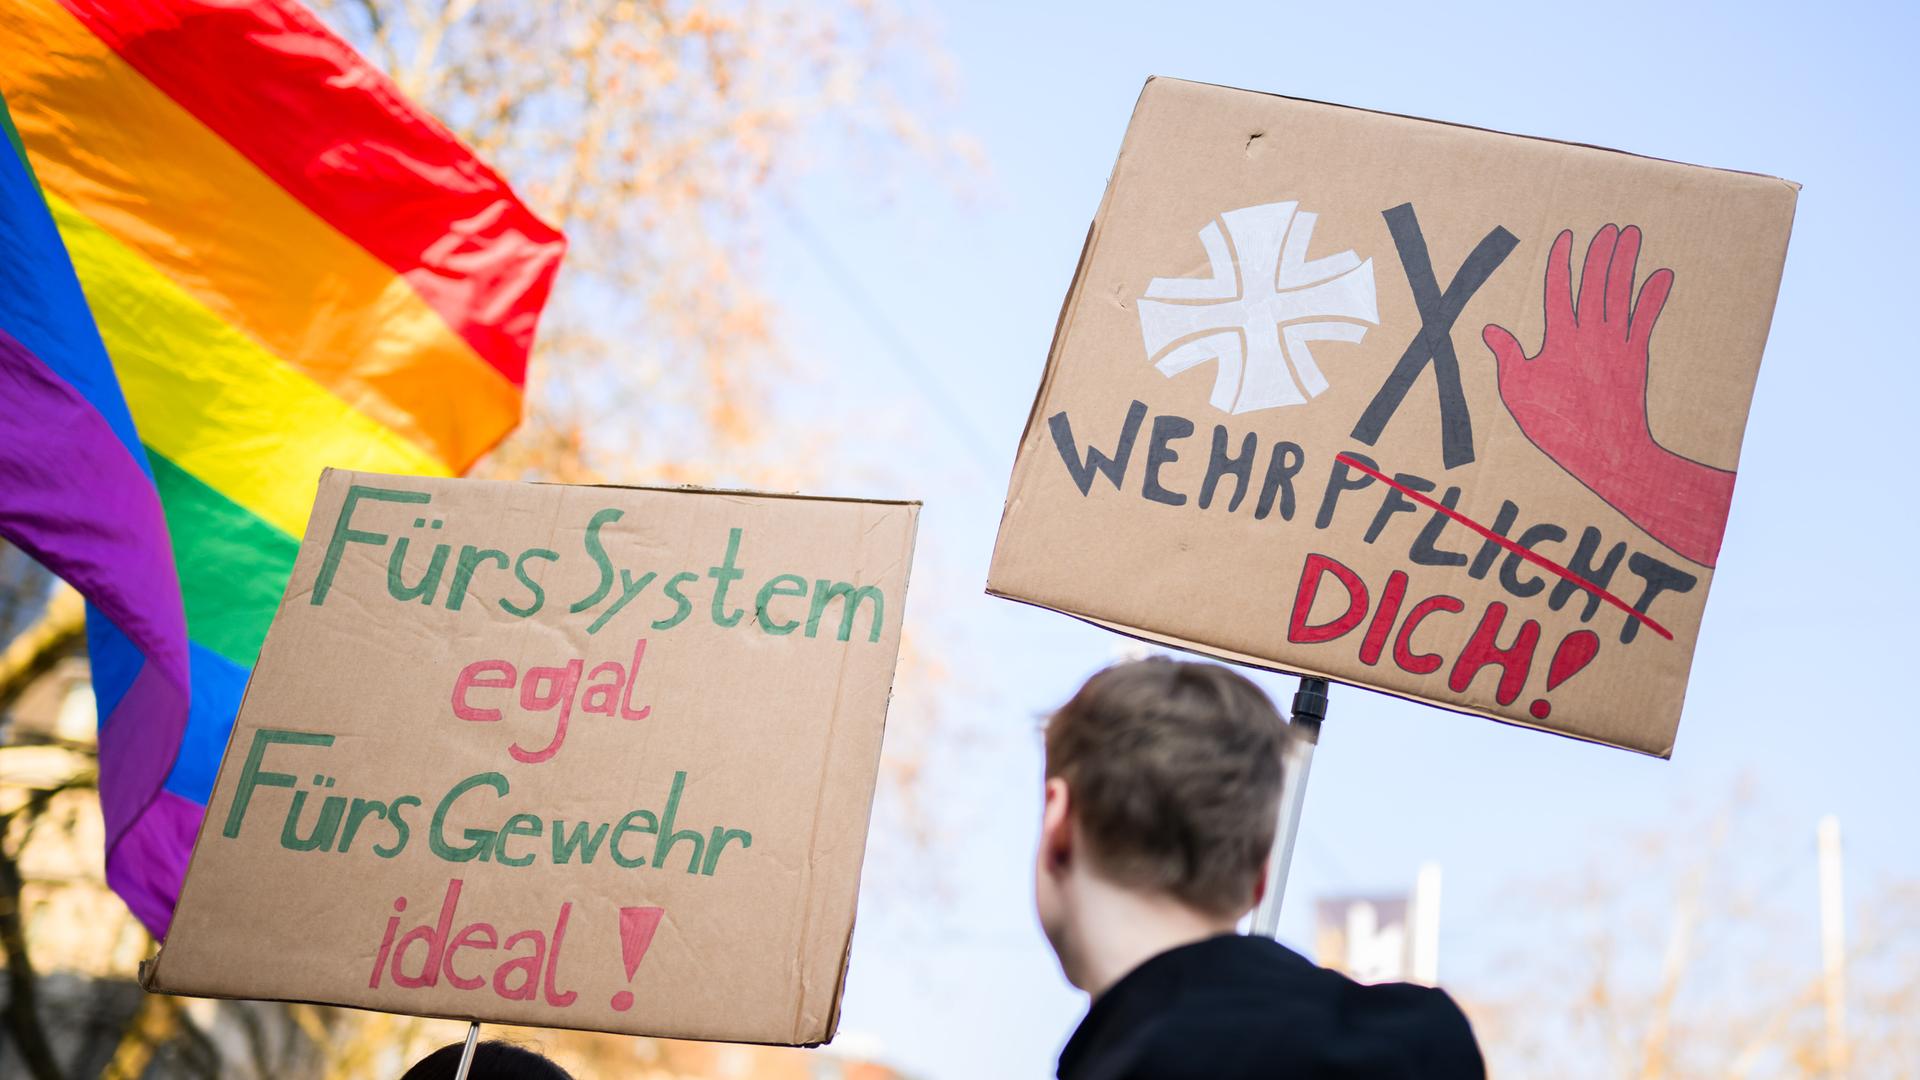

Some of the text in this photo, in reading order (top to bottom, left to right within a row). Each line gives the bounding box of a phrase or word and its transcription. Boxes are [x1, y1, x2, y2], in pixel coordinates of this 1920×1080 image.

[311, 485, 885, 644] Fürs System
[1286, 551, 1601, 720] DICH!
[450, 637, 652, 765] egal
[222, 729, 753, 877] Fürs Gewehr
[367, 878, 579, 1010] ideal
